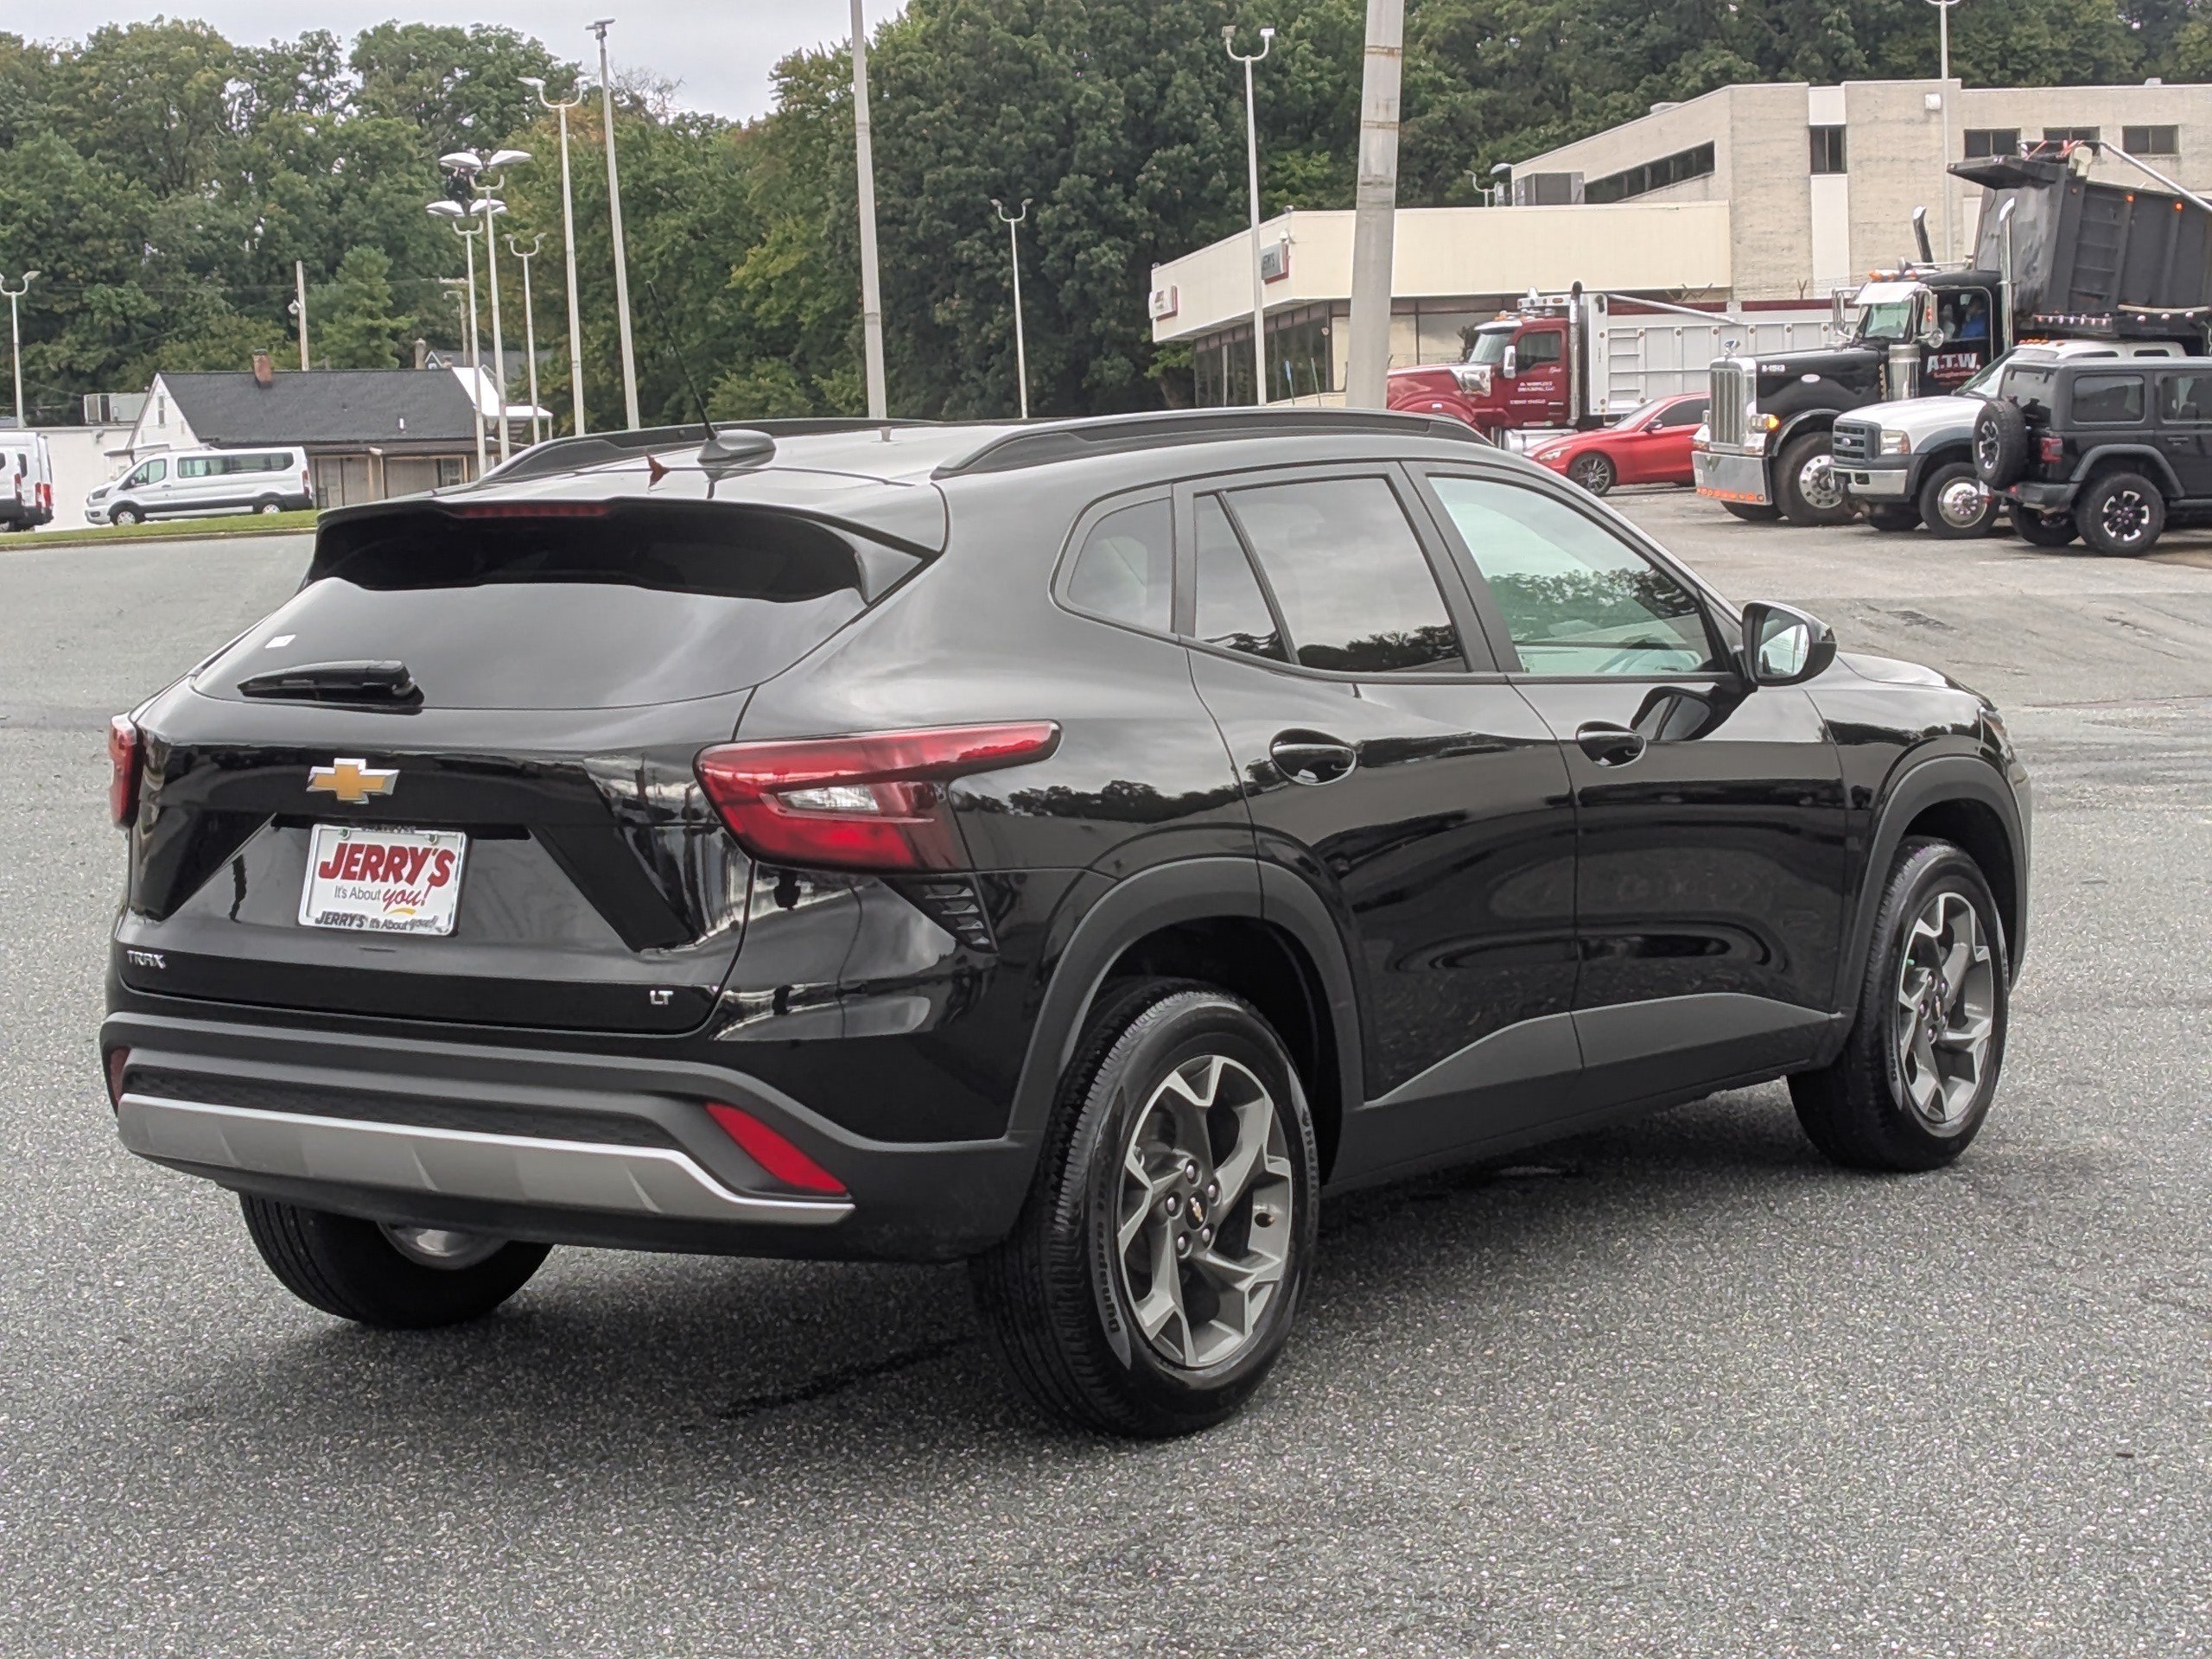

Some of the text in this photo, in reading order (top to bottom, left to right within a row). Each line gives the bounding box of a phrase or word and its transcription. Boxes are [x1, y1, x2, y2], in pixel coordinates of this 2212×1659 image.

[1927, 353, 1980, 372] A.T.W.
[318, 842, 456, 887] JERRY'S
[334, 883, 433, 912] It's About you!
[315, 911, 367, 928] JERRY'S
[381, 919, 407, 931] About
[127, 950, 166, 969] TRAX
[650, 990, 673, 1005] LT
